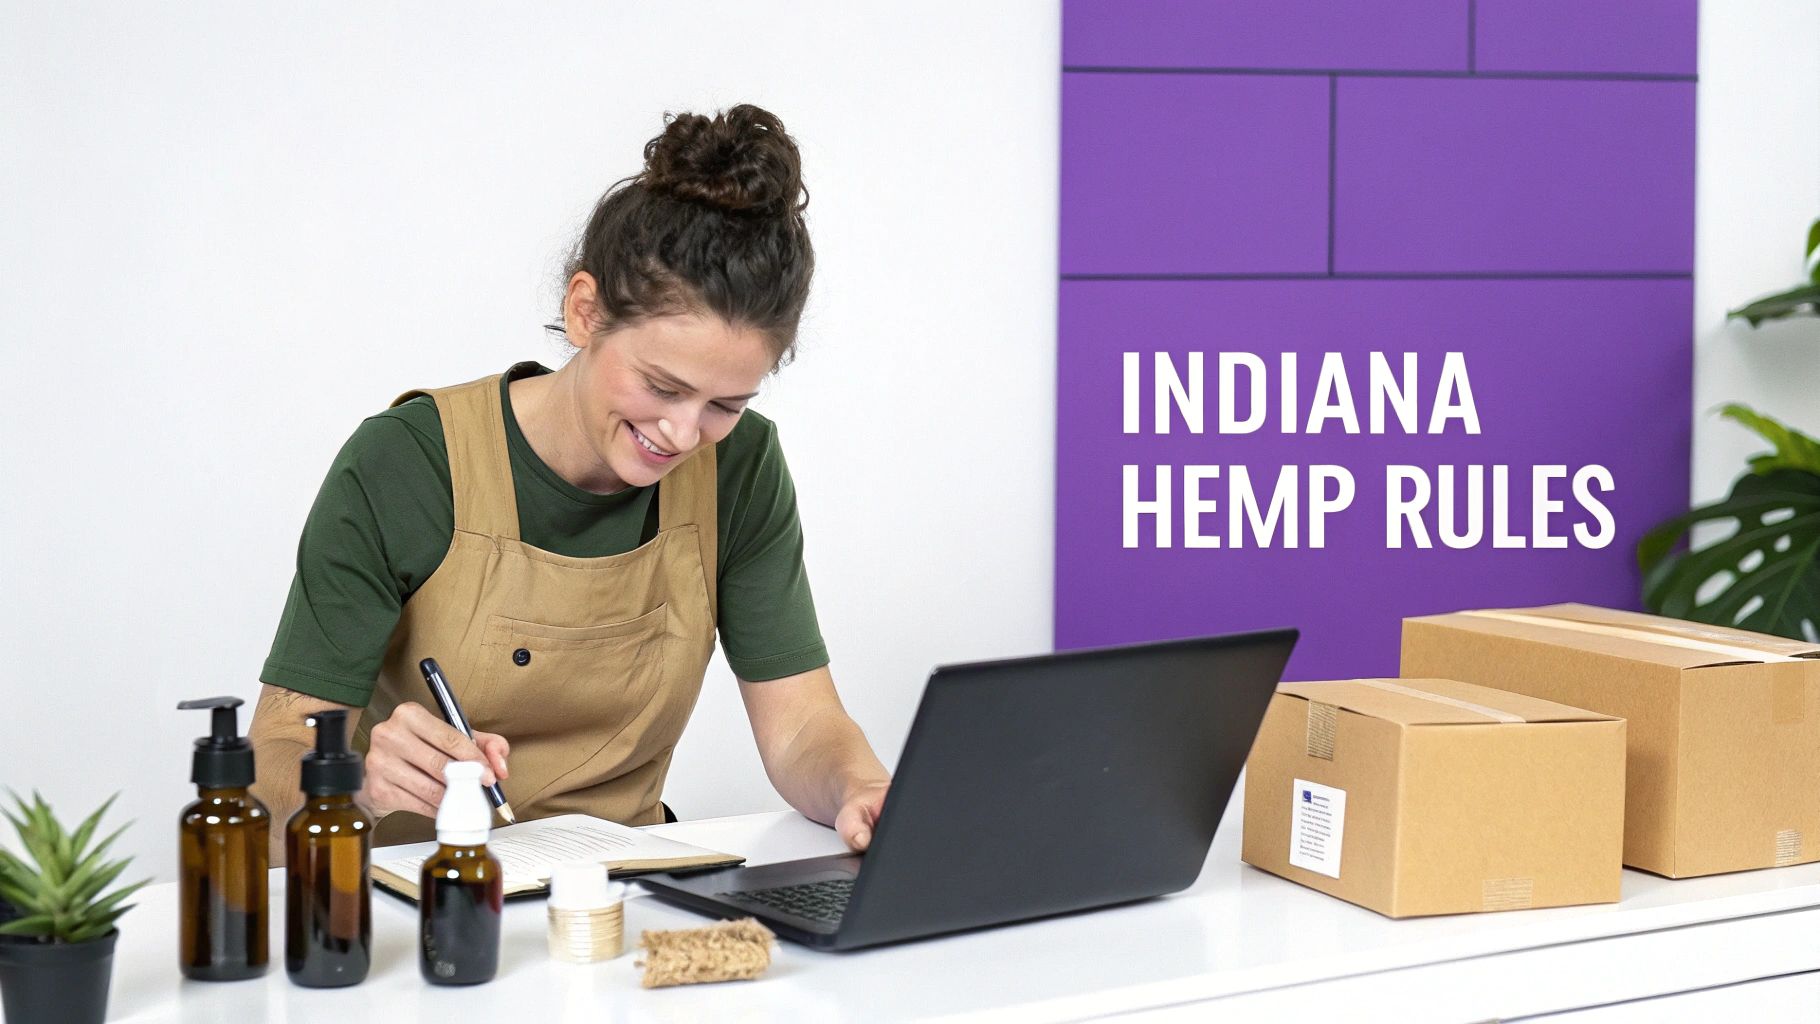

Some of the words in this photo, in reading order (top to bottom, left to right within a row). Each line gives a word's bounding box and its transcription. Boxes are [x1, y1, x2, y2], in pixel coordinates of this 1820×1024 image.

[1123, 352, 1481, 434] INDIANA
[1122, 464, 1356, 548] HEMP
[1386, 464, 1616, 549] RULES
